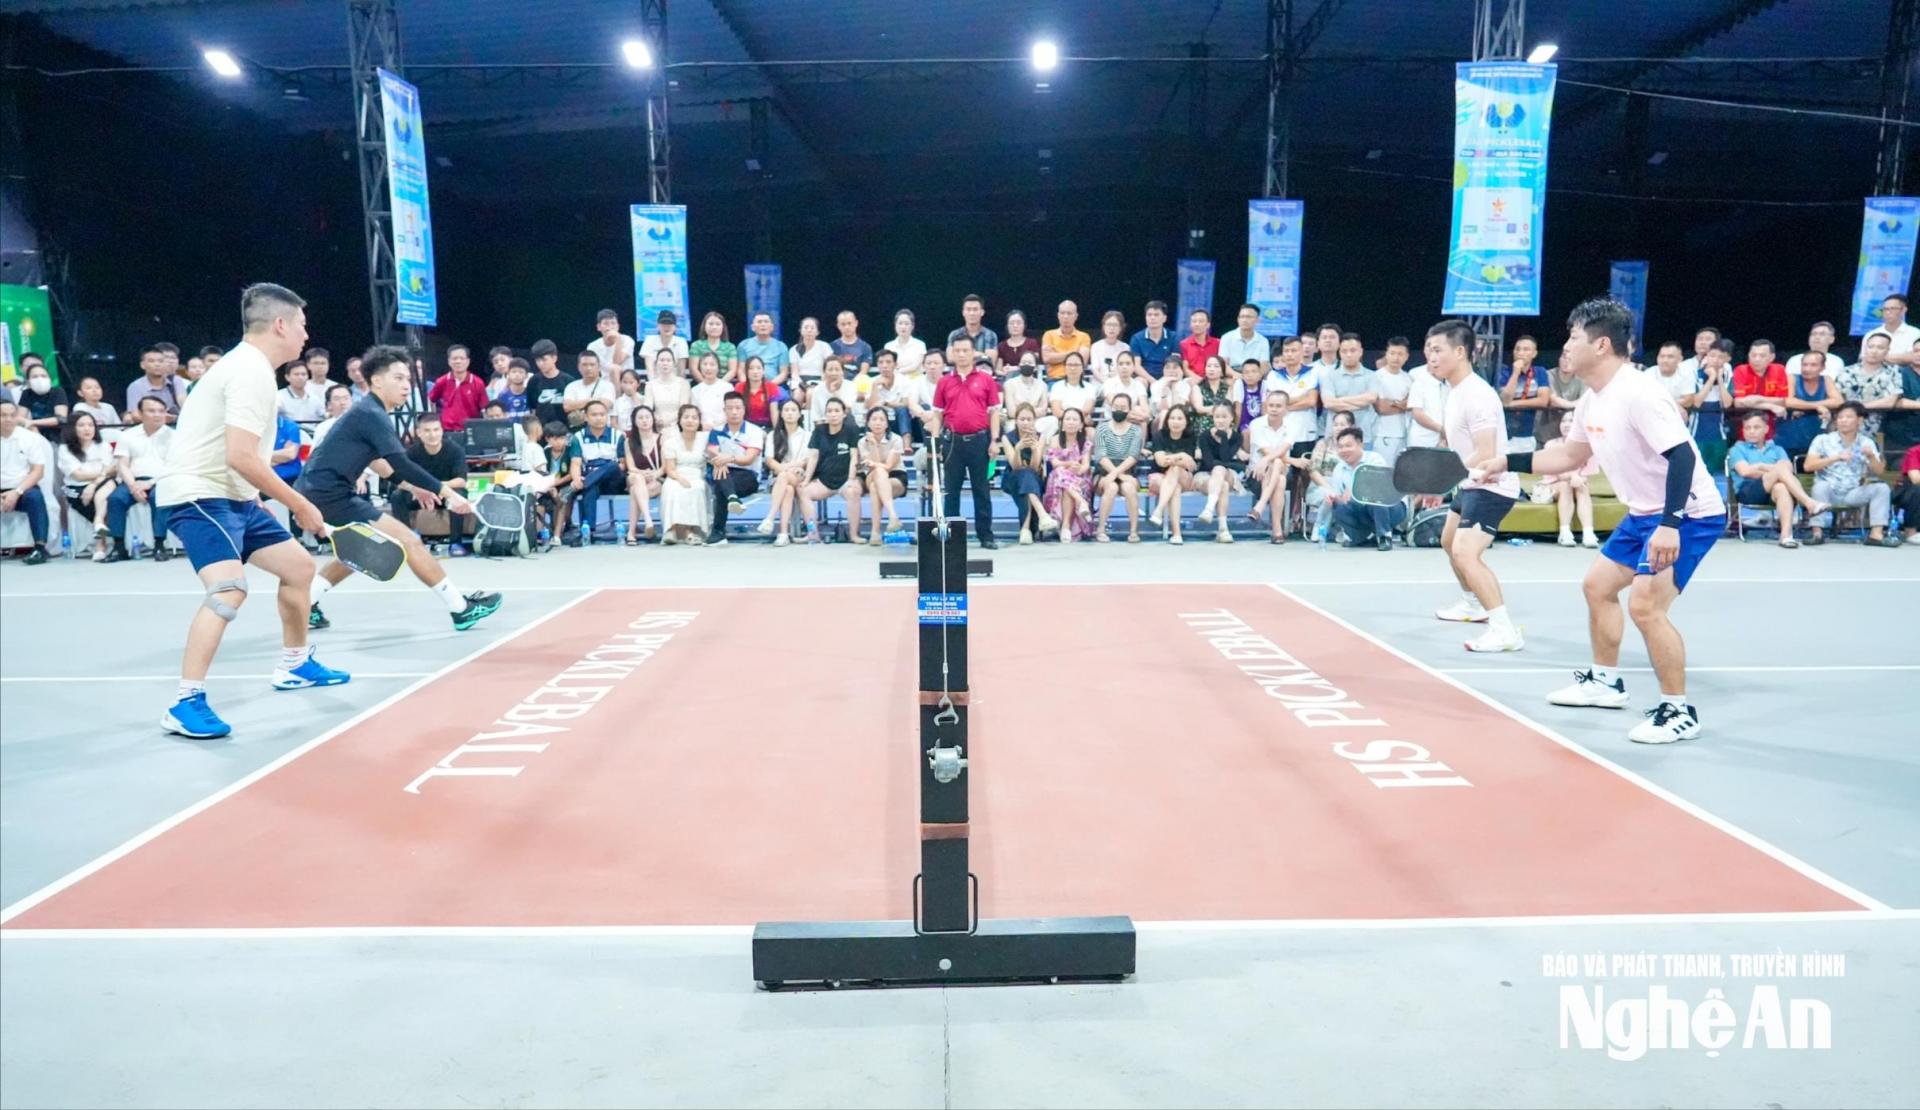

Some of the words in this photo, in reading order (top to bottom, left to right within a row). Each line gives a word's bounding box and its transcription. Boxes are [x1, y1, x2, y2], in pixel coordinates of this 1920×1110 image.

[403, 633, 676, 794] PICKLEBALL
[1177, 608, 1391, 728] PICKLEBALL
[1331, 739, 1474, 789] HS
